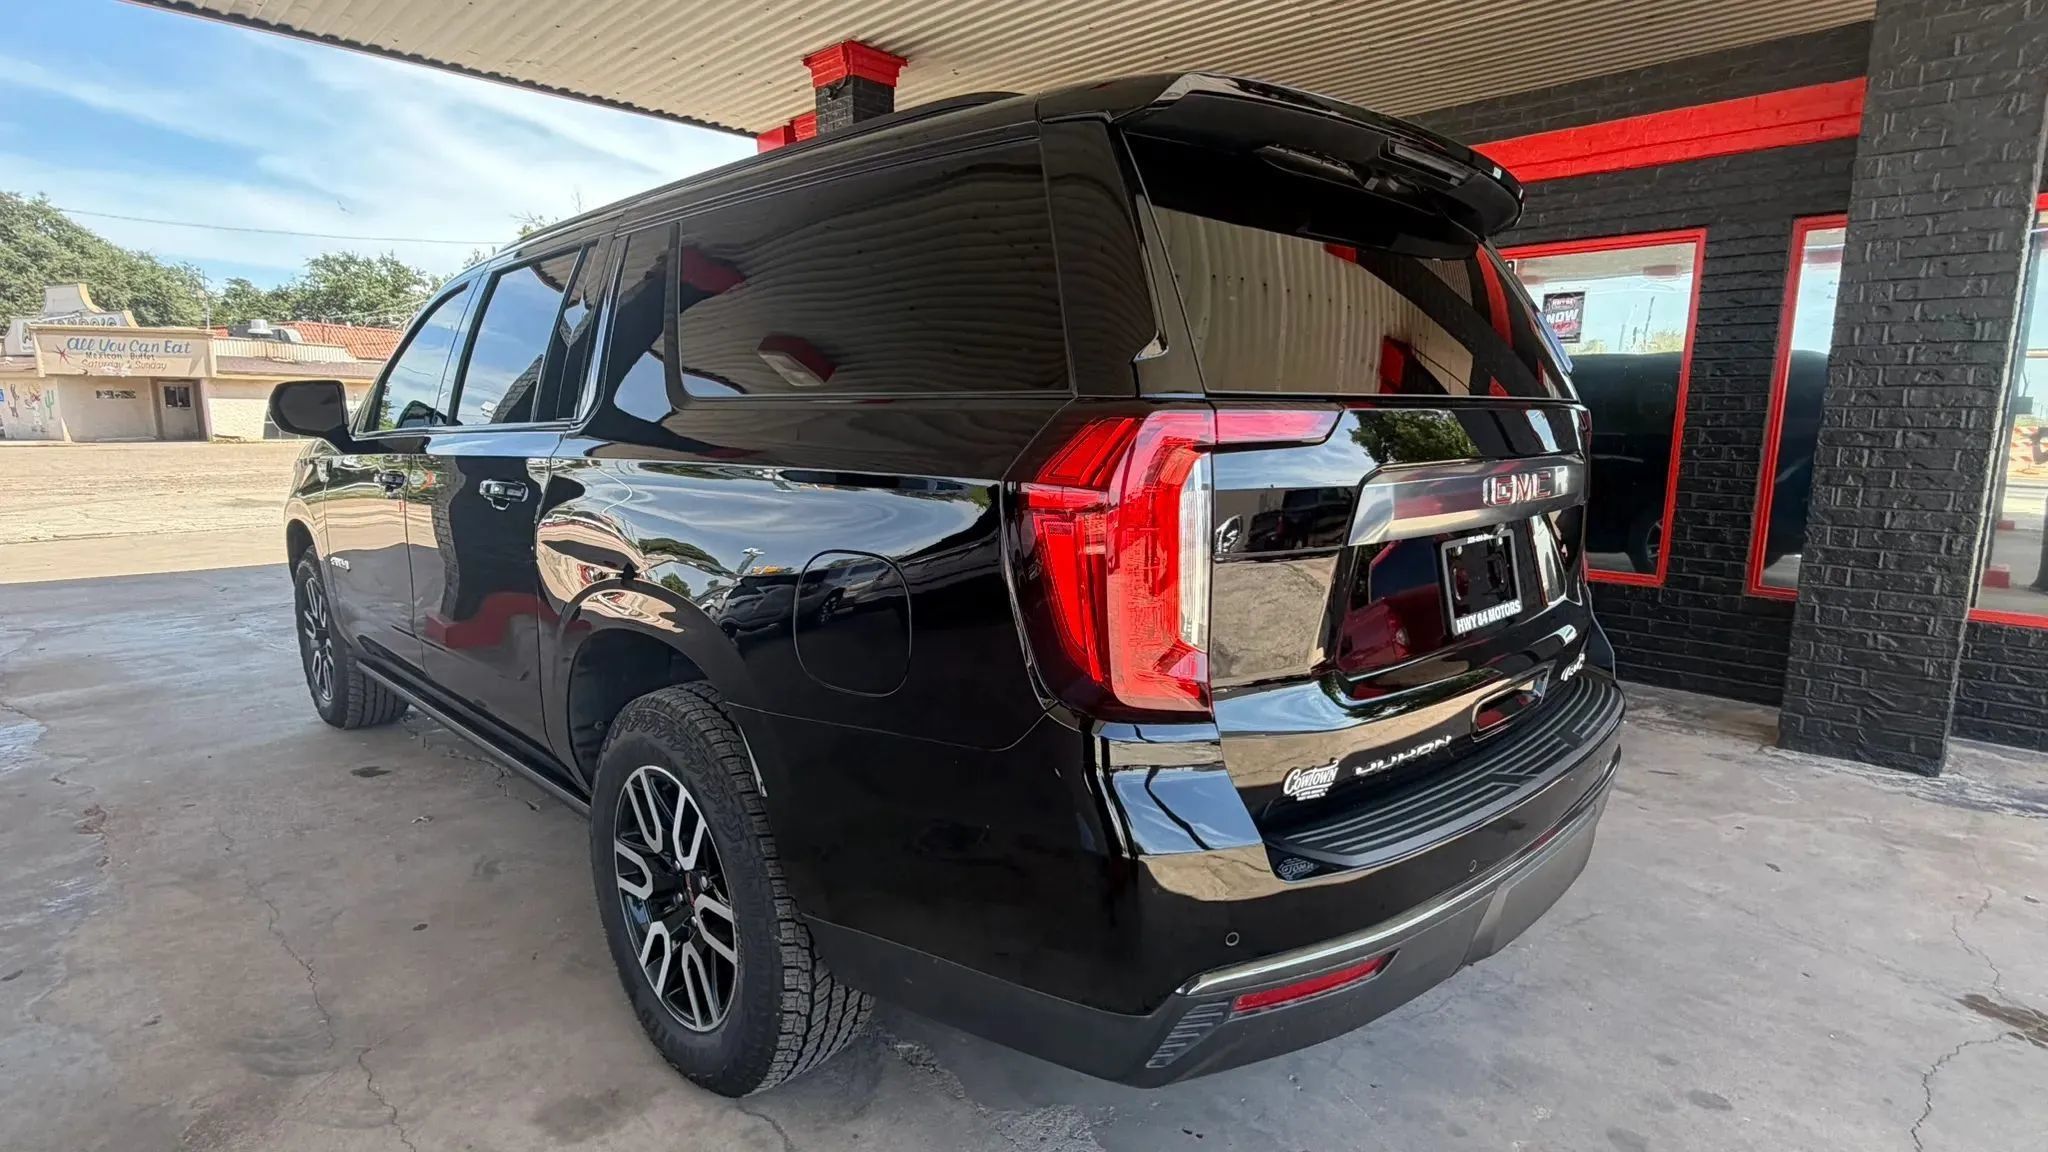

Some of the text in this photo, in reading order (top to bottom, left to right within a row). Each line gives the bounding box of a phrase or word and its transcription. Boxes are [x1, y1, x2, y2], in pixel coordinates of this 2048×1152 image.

[1546, 309, 1579, 323] NOW
[99, 339, 126, 352] You
[129, 339, 159, 353] Can
[164, 340, 192, 353] Eat
[85, 352, 123, 360] Mexican
[135, 361, 167, 370] Sunday
[1483, 471, 1551, 506] GMC
[1455, 600, 1521, 633] HWY 84 MOTORS
